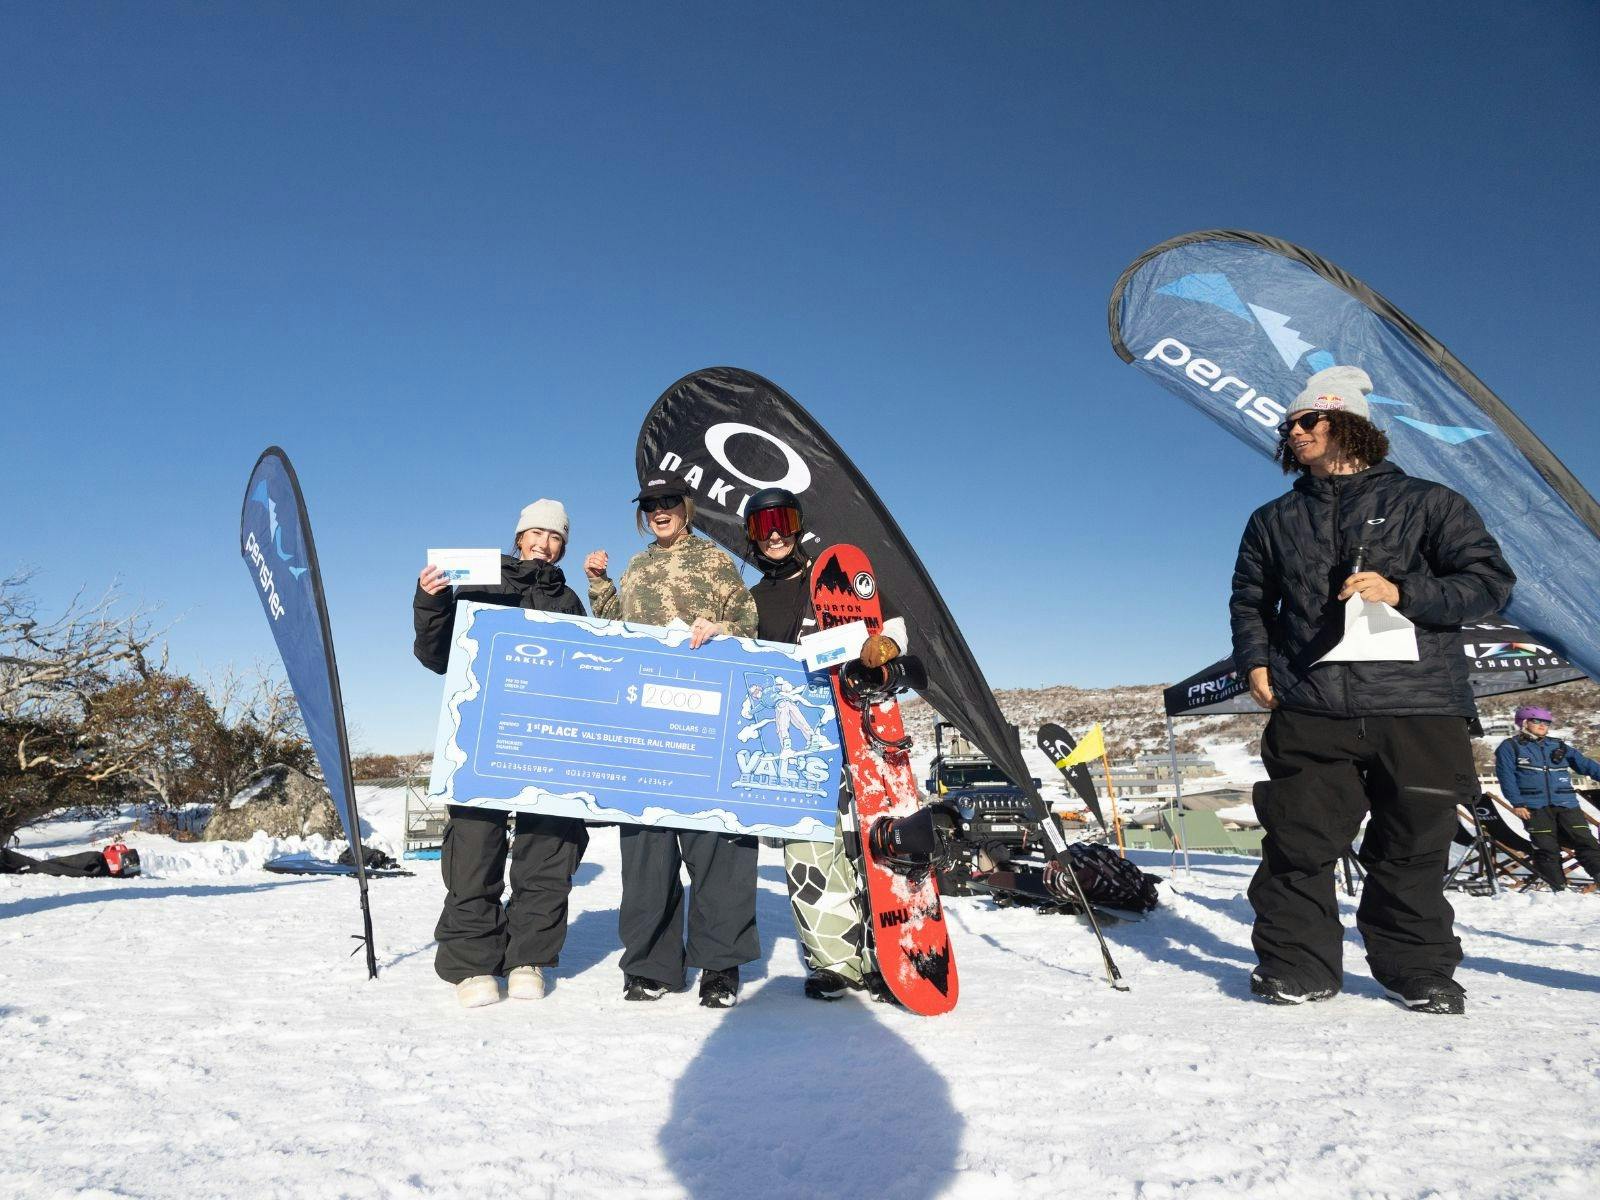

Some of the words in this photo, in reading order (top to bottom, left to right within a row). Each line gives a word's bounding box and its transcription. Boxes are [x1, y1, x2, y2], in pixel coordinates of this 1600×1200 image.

[1143, 337, 1288, 434] peris
[245, 531, 285, 621] perisher
[815, 604, 862, 612] BURTON
[505, 654, 555, 667] OAKLEY
[579, 663, 613, 672] perisher
[1475, 657, 1569, 669] CHNOLOG
[626, 685, 638, 704] $
[645, 686, 702, 710] 2000
[541, 724, 579, 738] PLACE
[582, 731, 602, 741] VAL'S
[603, 733, 622, 743] BLUE
[624, 736, 646, 746] STEEL
[647, 739, 664, 748] RAIL
[665, 741, 696, 751] RUMBLE
[669, 723, 699, 733] DOLLARS
[736, 749, 830, 783] VAL'S
[1042, 739, 1079, 777] OAKY
